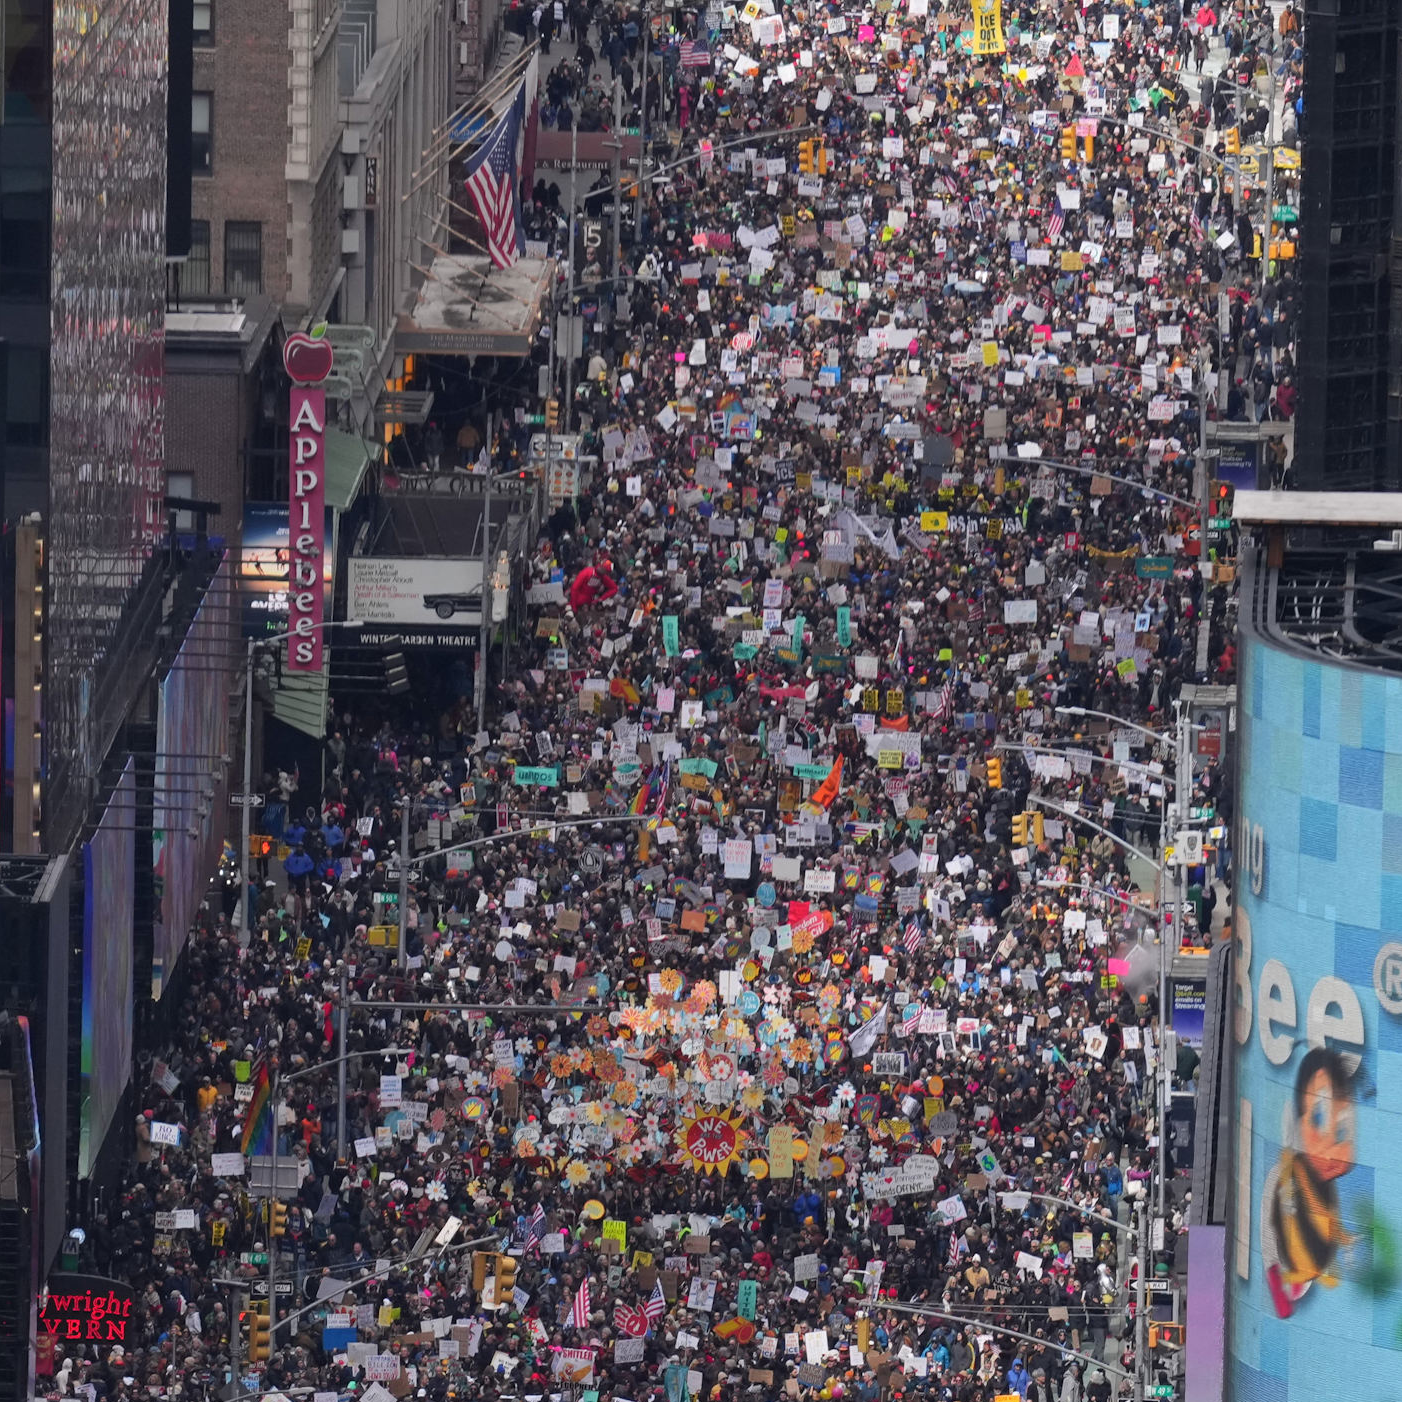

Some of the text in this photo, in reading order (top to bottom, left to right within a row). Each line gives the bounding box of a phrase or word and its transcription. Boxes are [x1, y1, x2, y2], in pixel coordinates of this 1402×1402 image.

[980, 14, 996, 28] ICE
[980, 28, 997, 39] OUT
[554, 160, 608, 169] Resaurant
[437, 635, 477, 646] THEATRE
[696, 1117, 726, 1134] WE
[689, 1139, 732, 1165] POWER
[562, 1347, 593, 1362] SHITLER
